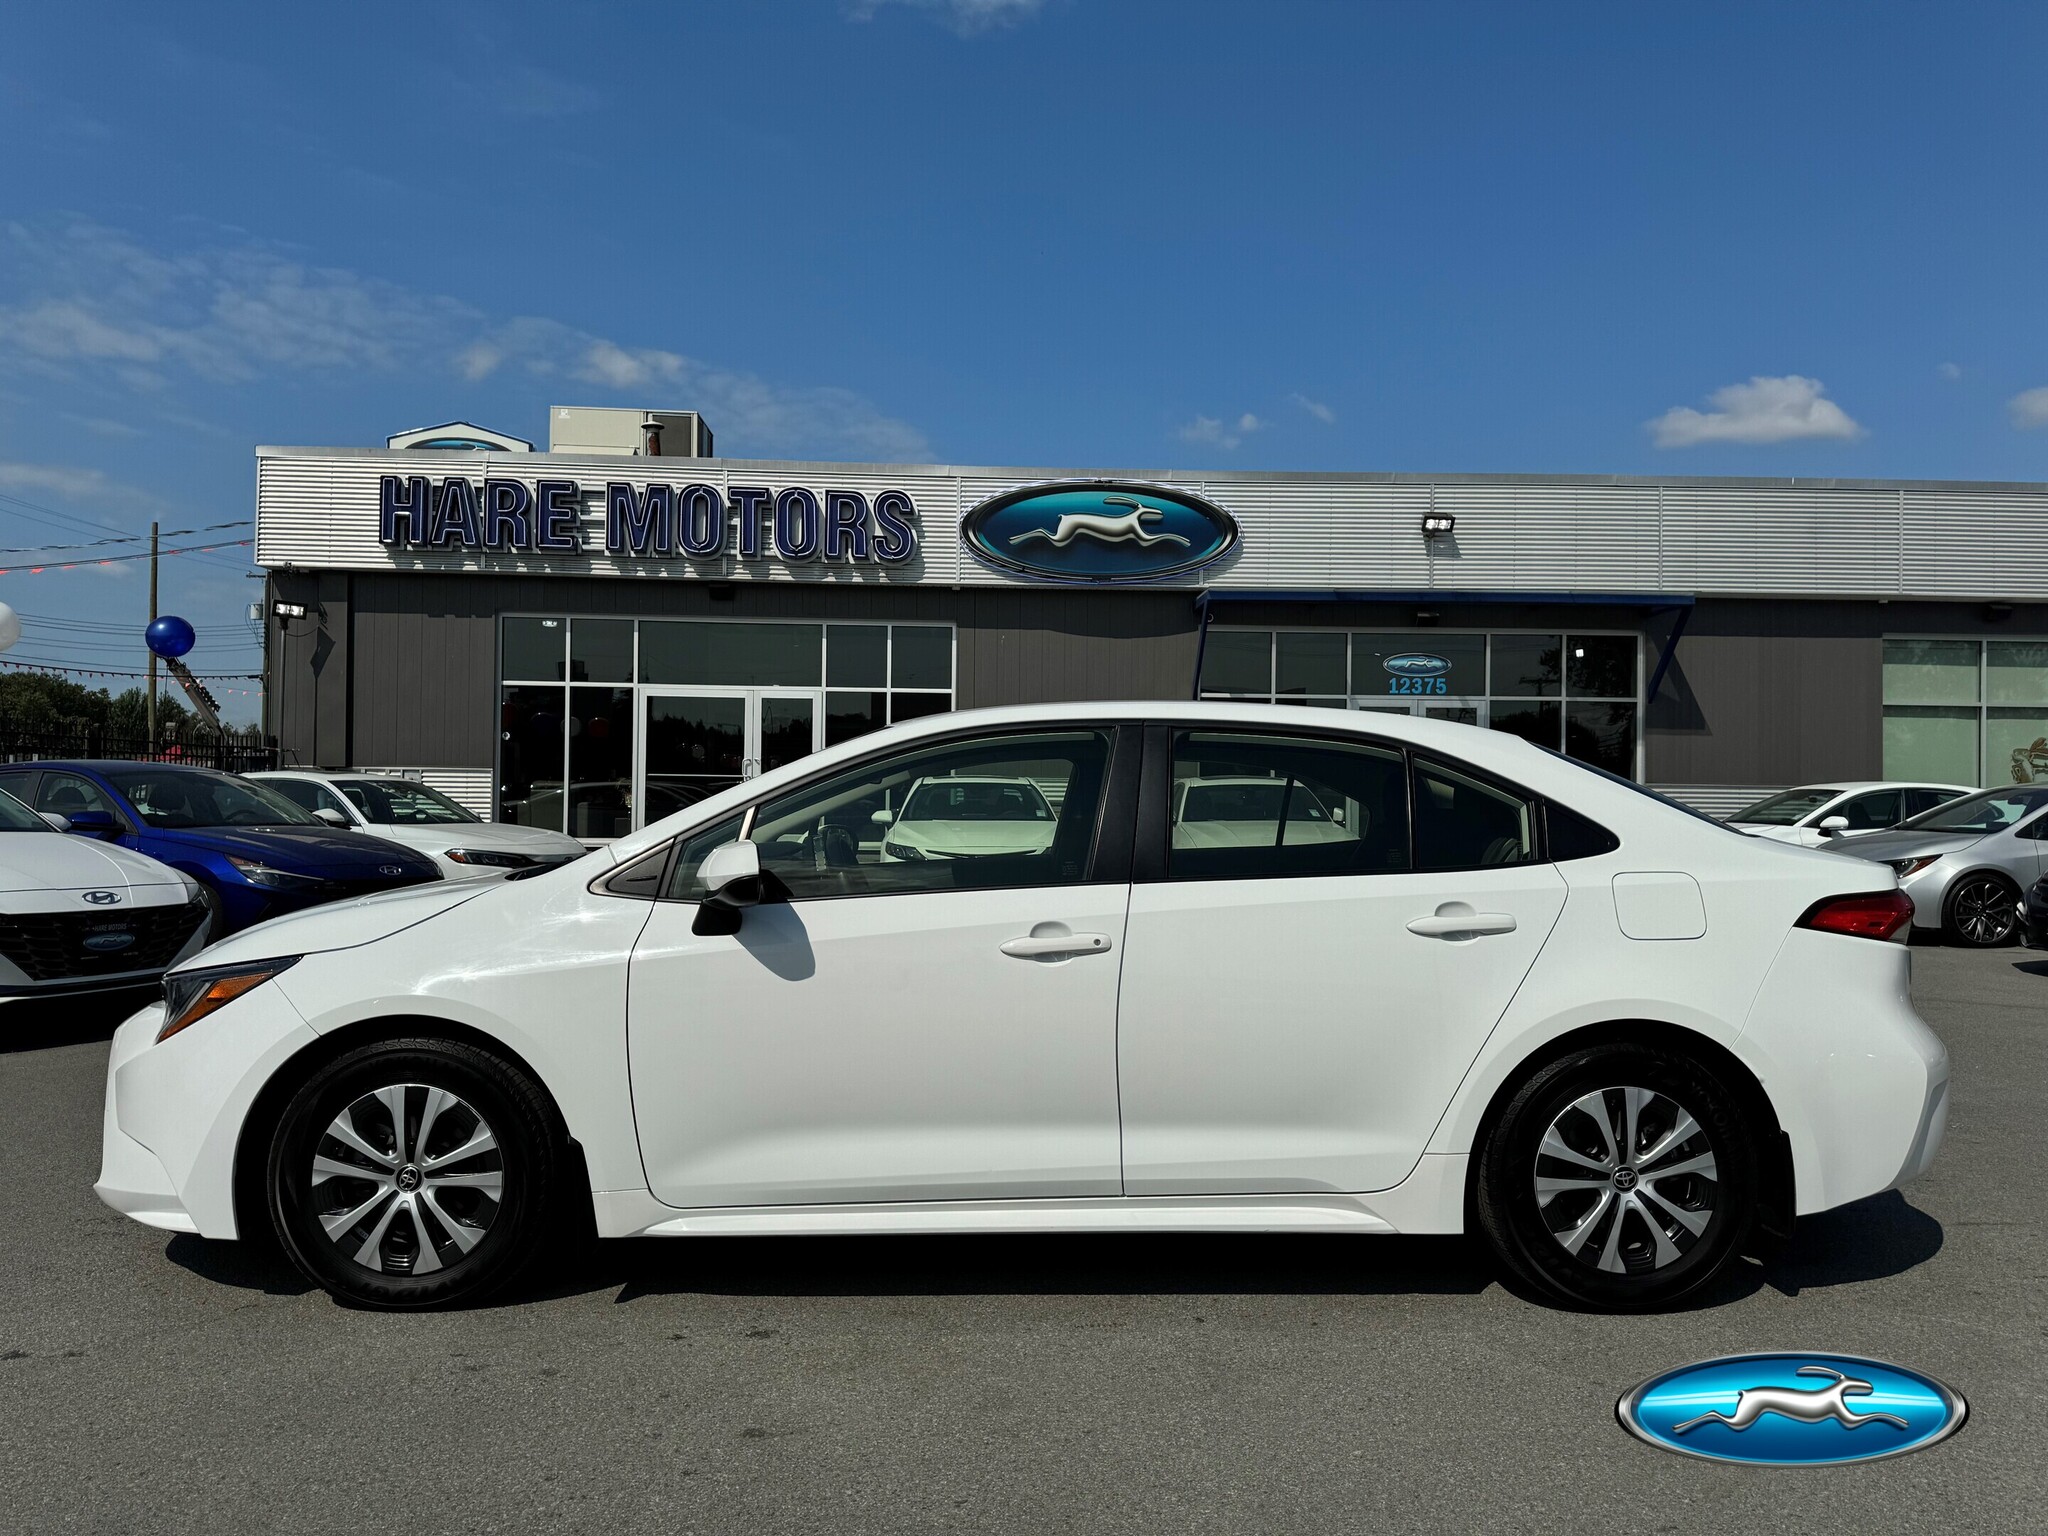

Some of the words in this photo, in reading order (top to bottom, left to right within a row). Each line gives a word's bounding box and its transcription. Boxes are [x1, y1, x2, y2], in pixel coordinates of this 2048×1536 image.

[379, 475, 579, 552] HARE
[605, 481, 917, 562] MOTORS
[1389, 677, 1447, 695] 12375
